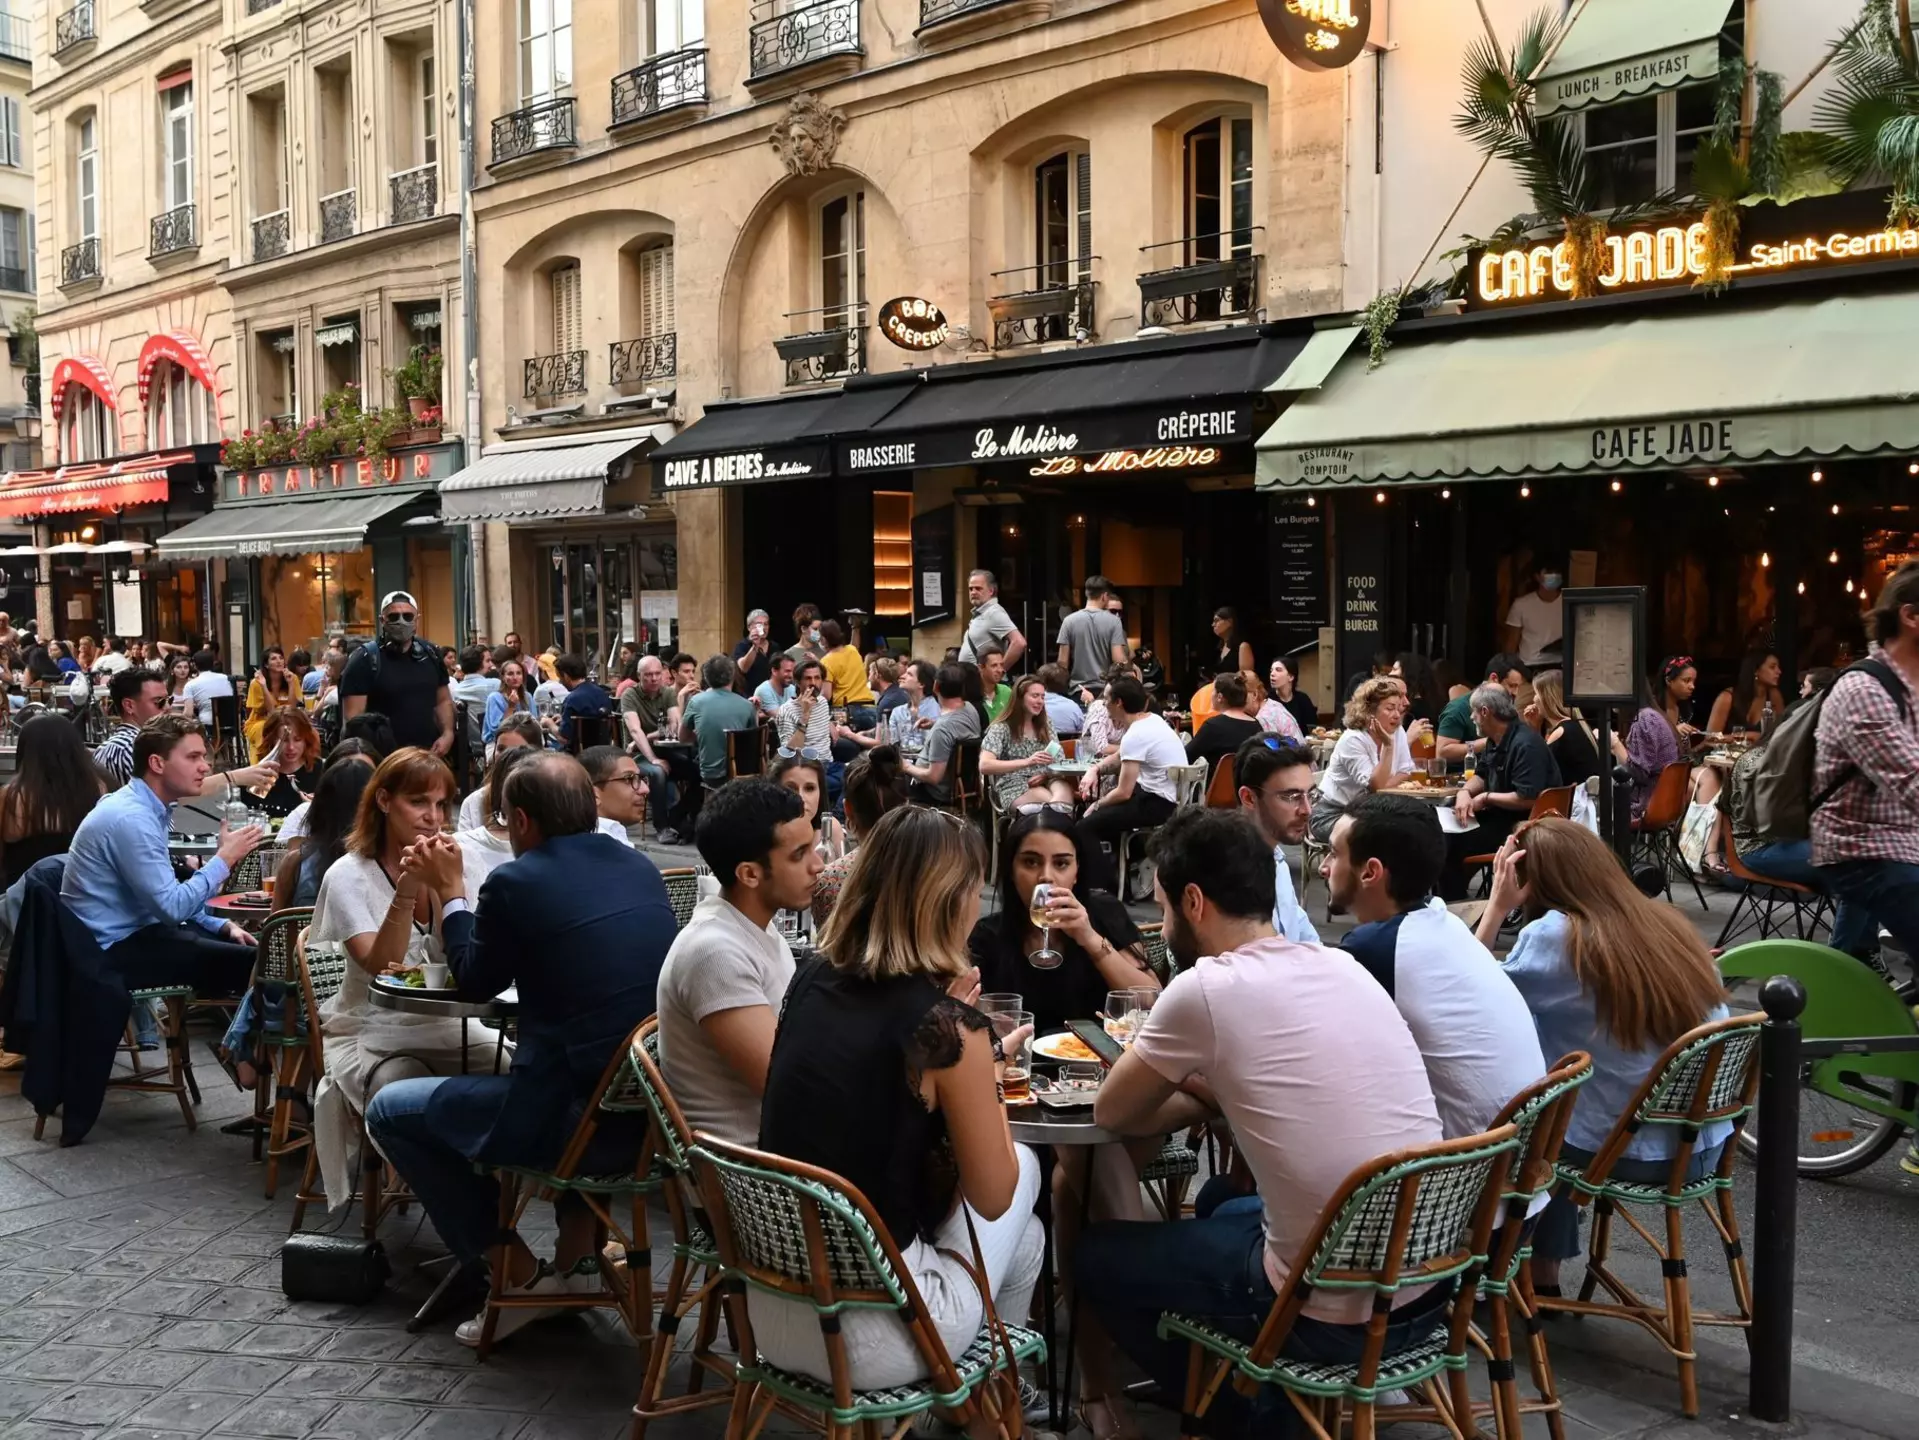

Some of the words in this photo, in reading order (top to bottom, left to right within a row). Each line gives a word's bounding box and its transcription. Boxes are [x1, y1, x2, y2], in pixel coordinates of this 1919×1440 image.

[1558, 77, 1599, 99] LUNCH
[1615, 55, 1690, 86] BREAKFAST
[1479, 242, 1573, 301] CAFE
[1598, 222, 1709, 287] JADE
[1751, 229, 1919, 268] Saint-Germa
[1157, 411, 1236, 440] CRÊPERIE
[971, 428, 999, 459] Le
[1001, 424, 1079, 457] Molière
[1592, 425, 1656, 460] CAFE
[1666, 420, 1733, 455] JADE
[850, 443, 916, 469] BRASSERIE
[1029, 455, 1077, 476] Le
[1298, 447, 1354, 464] RESTAURANT
[236, 454, 430, 496] TRAITEUR
[664, 459, 699, 487] CAVE
[701, 458, 711, 484] A
[713, 453, 764, 482] BIERES
[1304, 464, 1348, 476] COMPTOIR
[1274, 516, 1288, 524] Les
[1290, 515, 1320, 525] Burgers
[1347, 576, 1376, 588] FOOD
[1357, 589, 1366, 599] &
[1346, 600, 1379, 612] DRINK
[1345, 619, 1379, 631] BURGER
